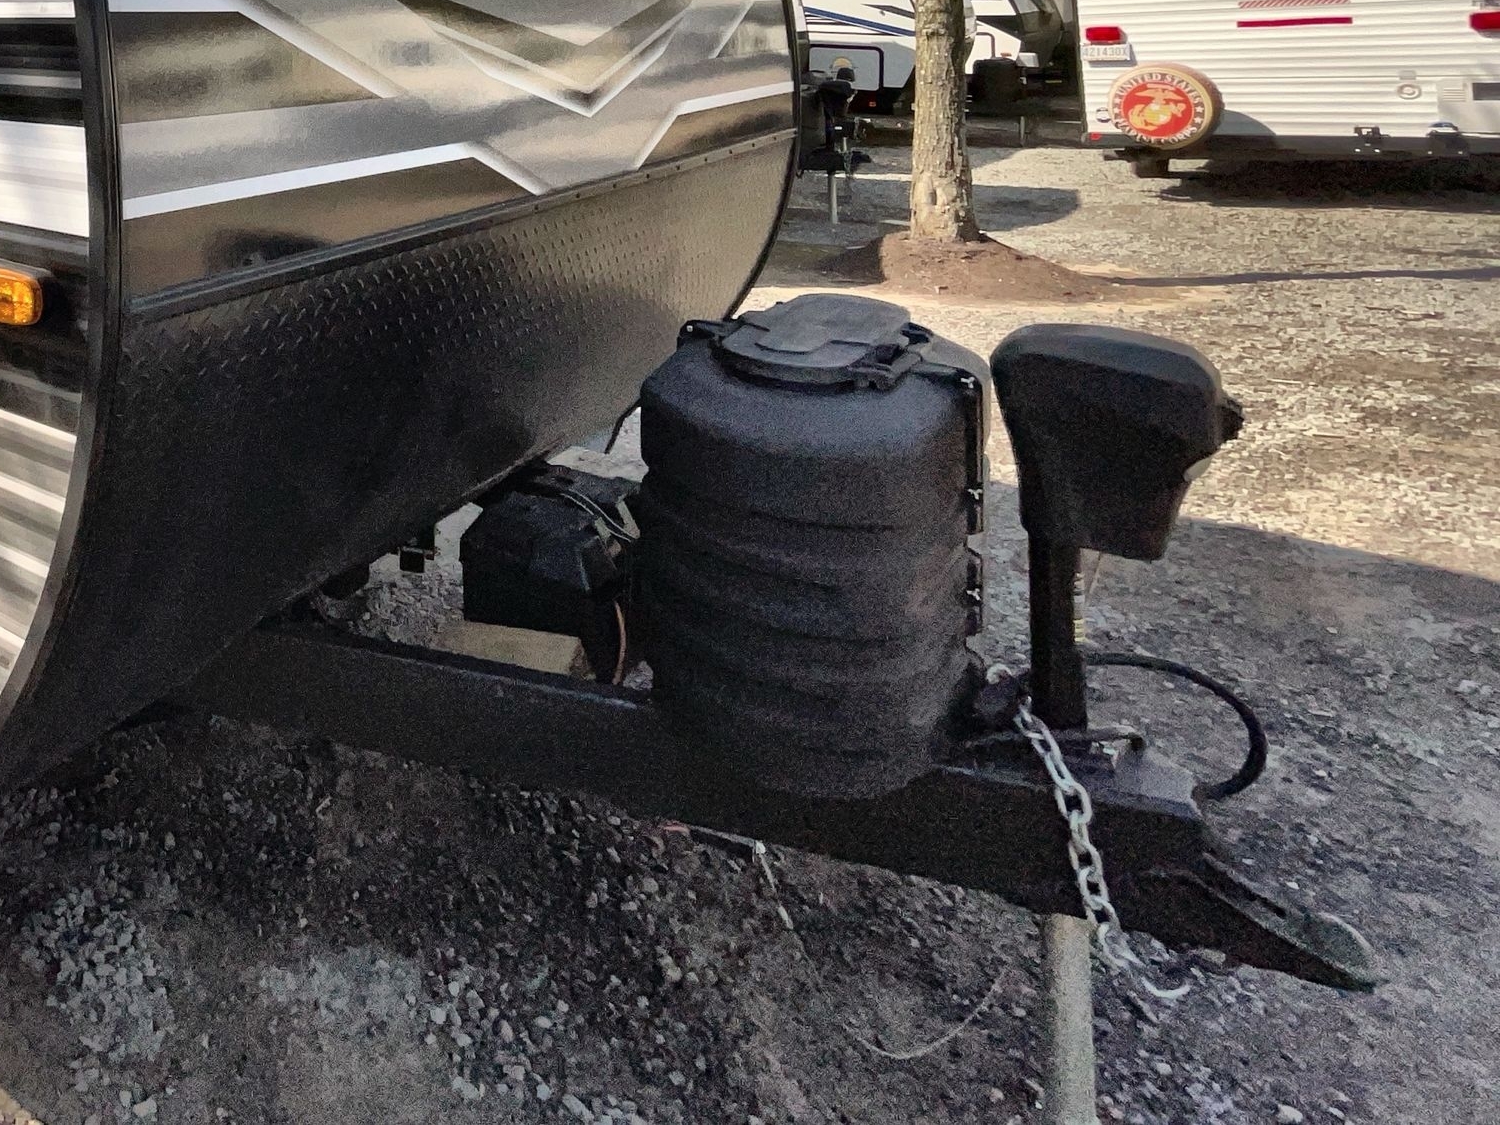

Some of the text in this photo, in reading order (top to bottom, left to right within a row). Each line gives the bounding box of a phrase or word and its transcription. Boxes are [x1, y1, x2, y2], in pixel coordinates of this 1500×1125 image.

[1116, 73, 1201, 104] UNITED STATES
[1160, 126, 1198, 144] CORPS
